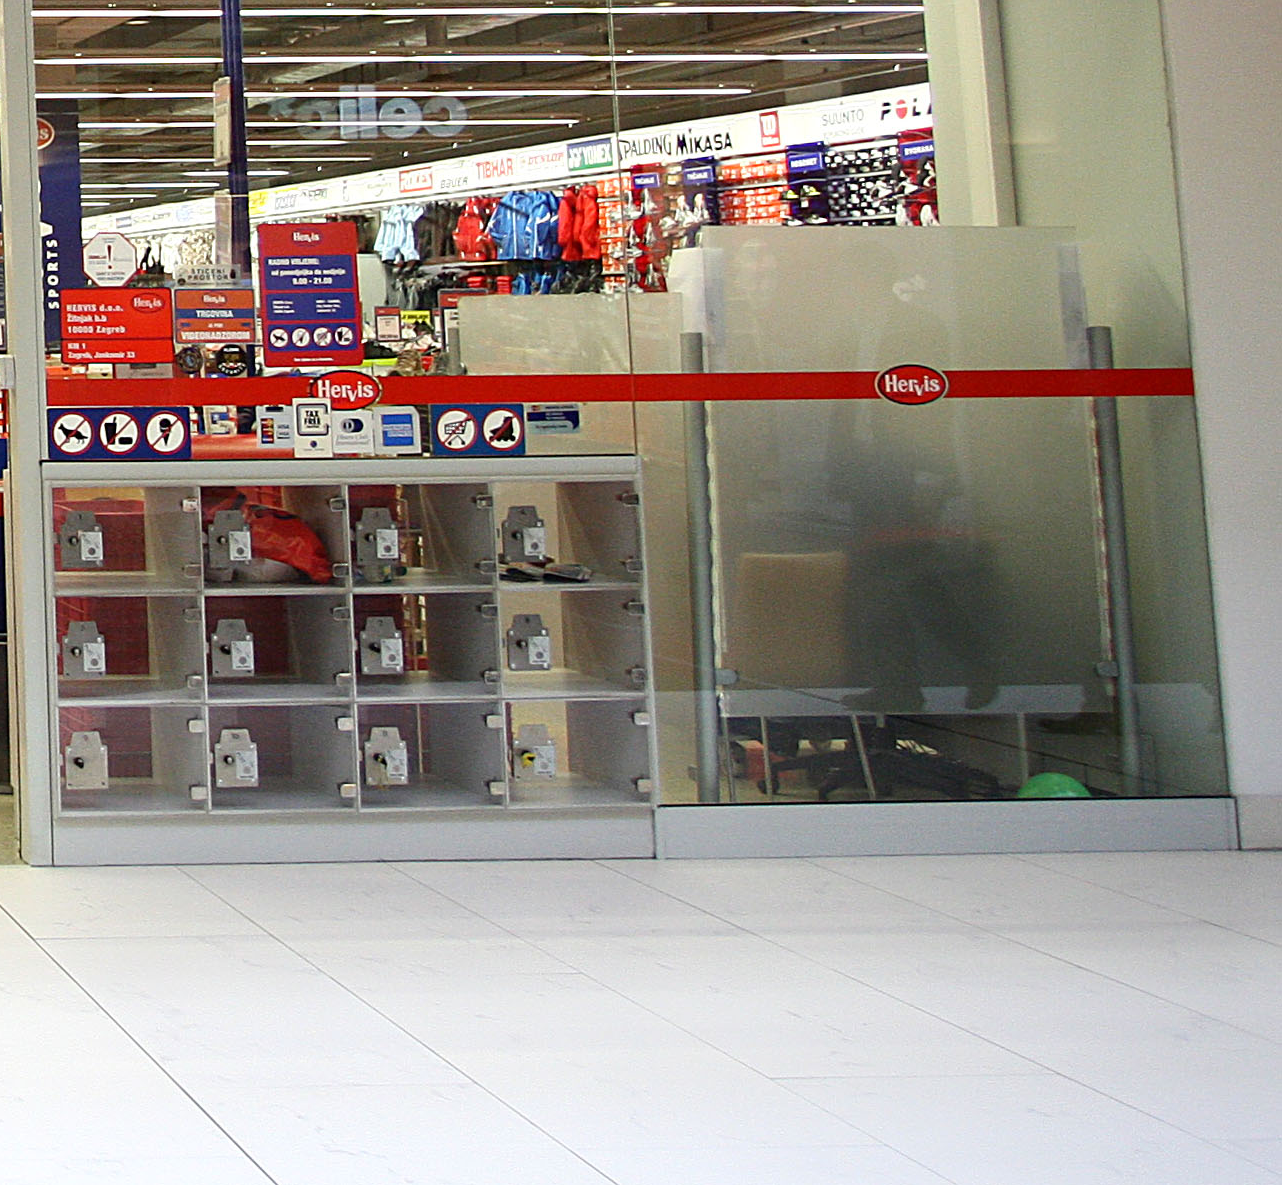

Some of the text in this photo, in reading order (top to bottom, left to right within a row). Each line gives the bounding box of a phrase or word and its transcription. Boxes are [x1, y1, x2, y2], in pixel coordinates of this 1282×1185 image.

[822, 109, 865, 126] SUUNTO
[476, 158, 514, 180] TIBHAR
[47, 238, 60, 309] SPORTS
[317, 380, 375, 403] Hervis
[884, 374, 941, 397] Hervis
